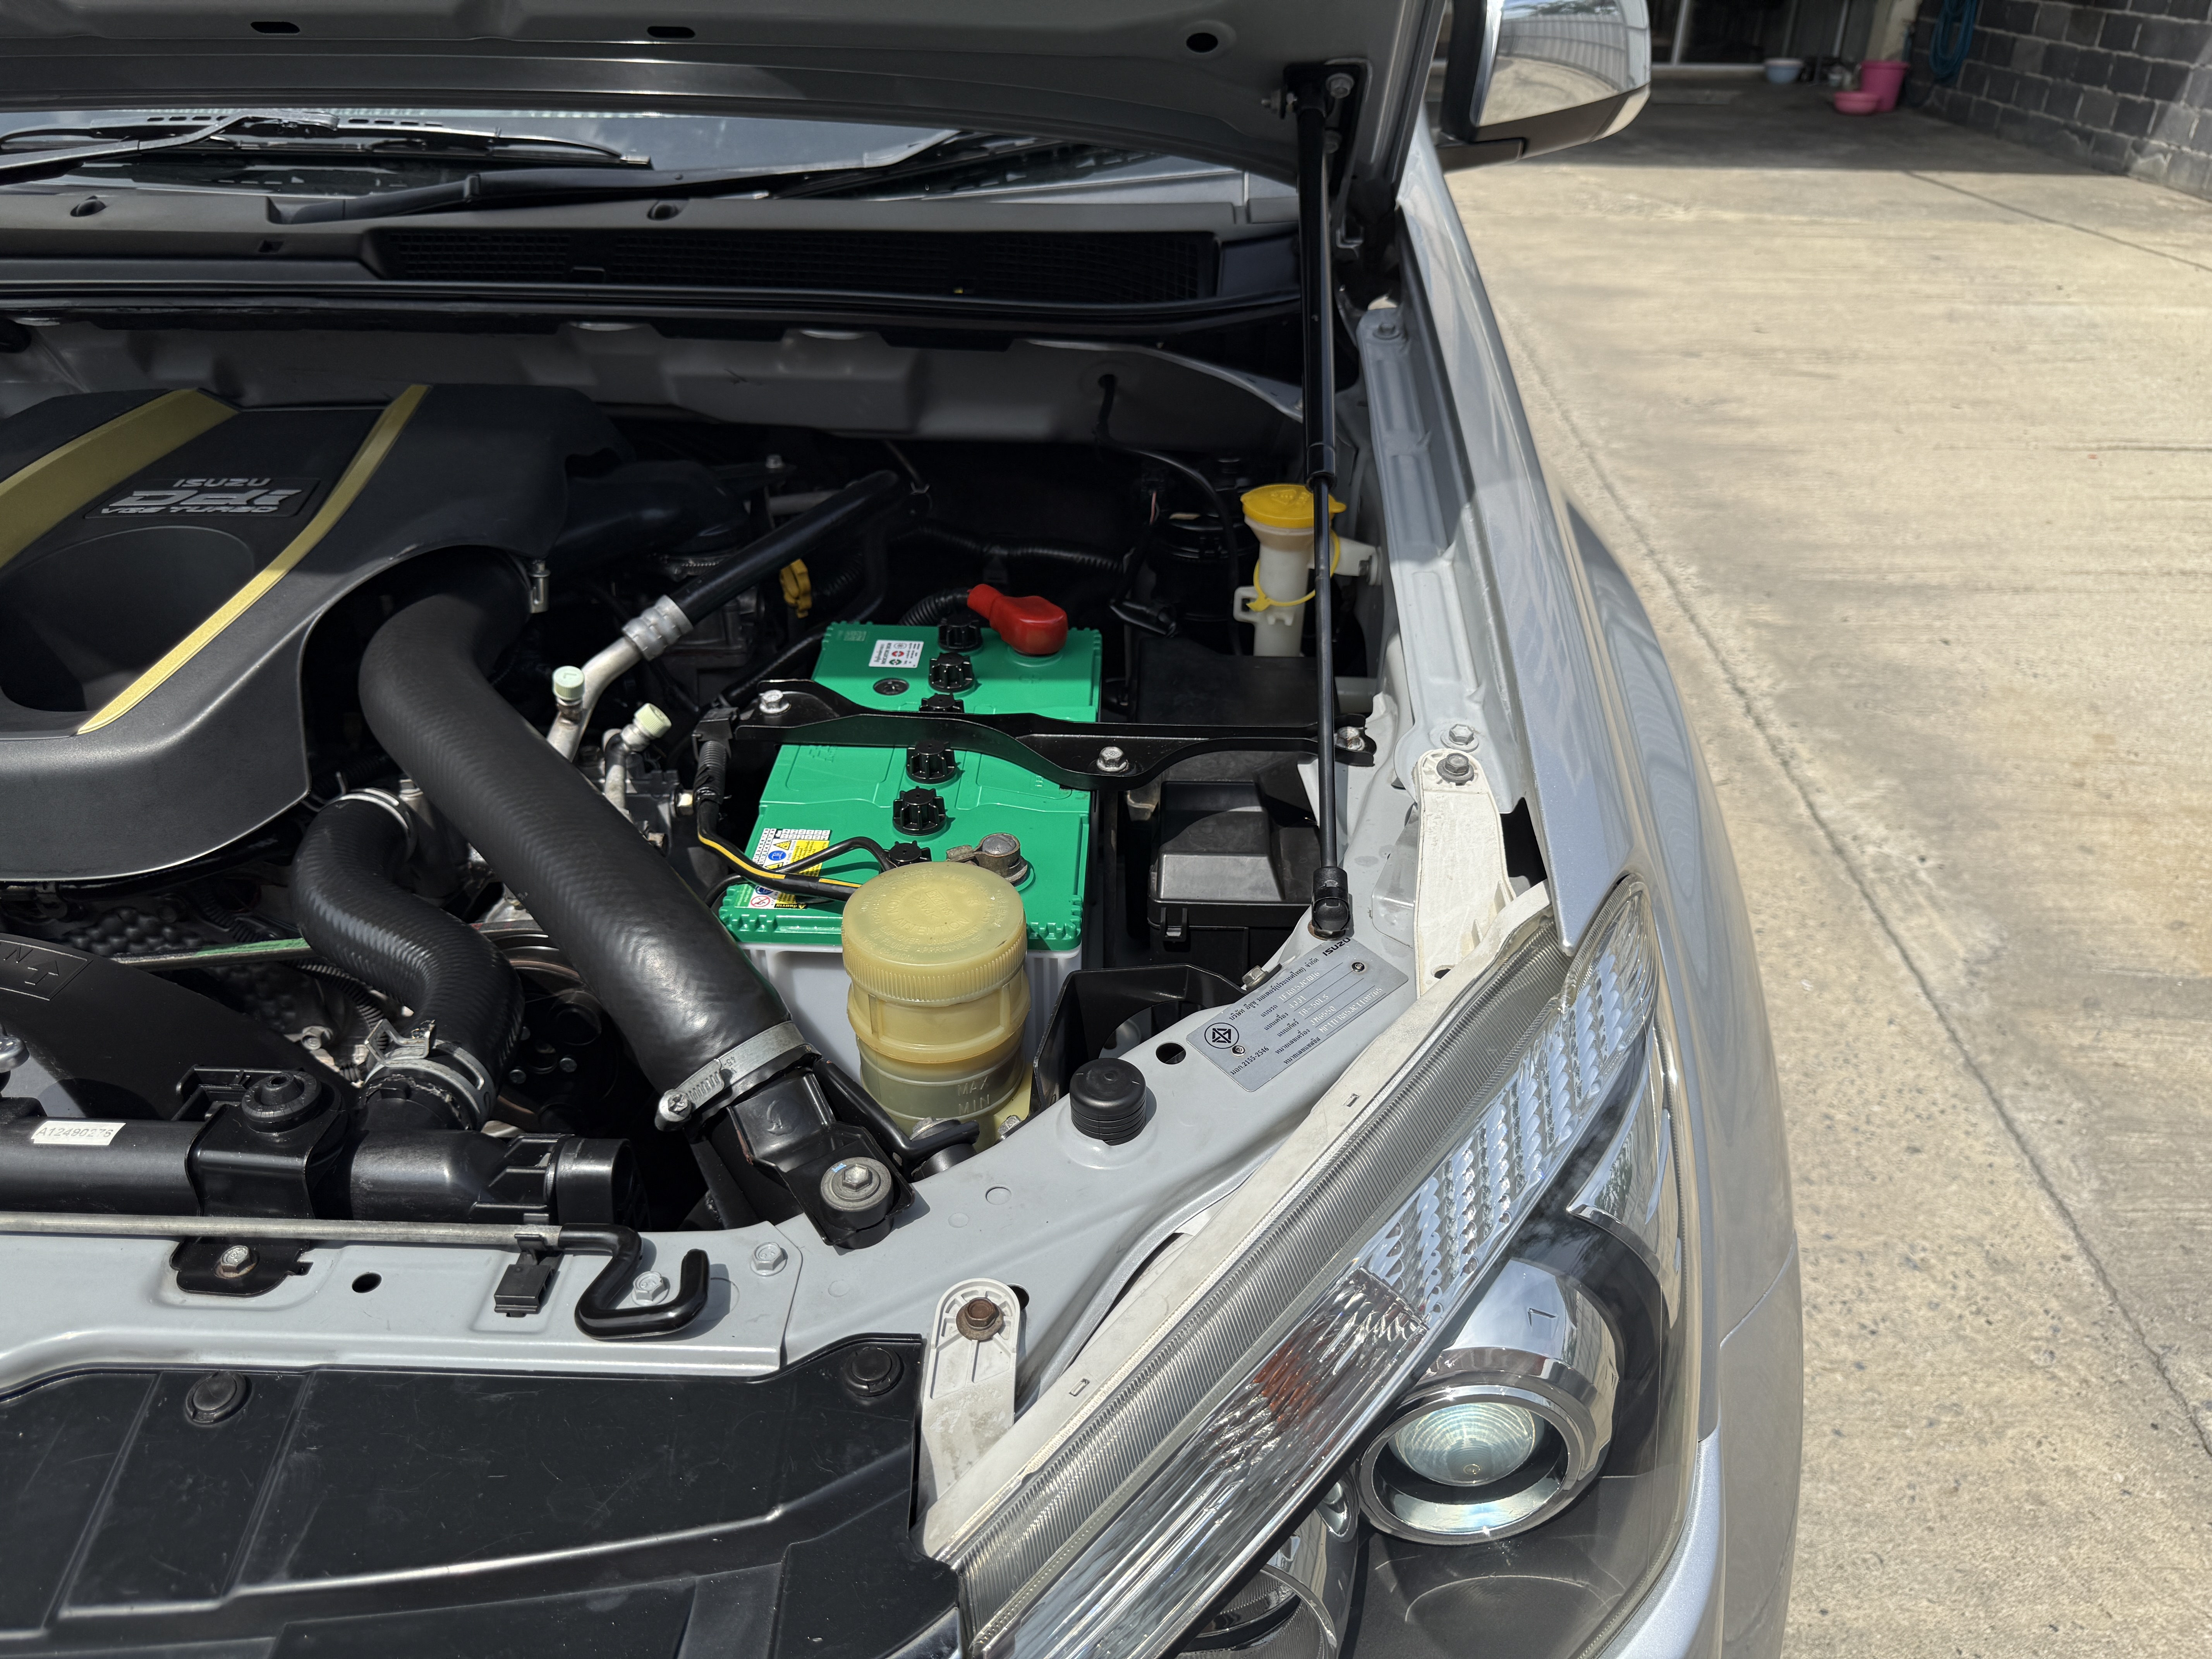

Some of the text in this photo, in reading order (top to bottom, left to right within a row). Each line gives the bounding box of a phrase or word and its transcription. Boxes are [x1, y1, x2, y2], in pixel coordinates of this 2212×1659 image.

[173, 478, 271, 487] ISUZU
[169, 505, 278, 514] TURBO
[888, 881, 928, 915] CAUTION
[880, 925, 980, 945] EMPLOYER UNIQUEMENT
[892, 917, 970, 935] ATTENTION
[869, 930, 880, 939] UN
[880, 938, 911, 952] FLUIDE
[969, 935, 983, 944] DE
[1322, 938, 1351, 956] ISUZU
[1229, 1008, 1245, 1021] บริษัท
[1245, 998, 1259, 1011] อีซูซุ
[1305, 957, 1319, 968] จำกัด
[1261, 1004, 1278, 1017] แบบรถ
[1264, 1012, 1289, 1031] แบบเครื่อง
[1277, 1018, 1299, 1037] แบบเกียร์
[1275, 1028, 1310, 1054] หมายเลขเครื่อง
[1230, 1046, 1270, 1075] มอก.2155-2546
[957, 1075, 989, 1096] MAX
[958, 1094, 990, 1116] MIN
